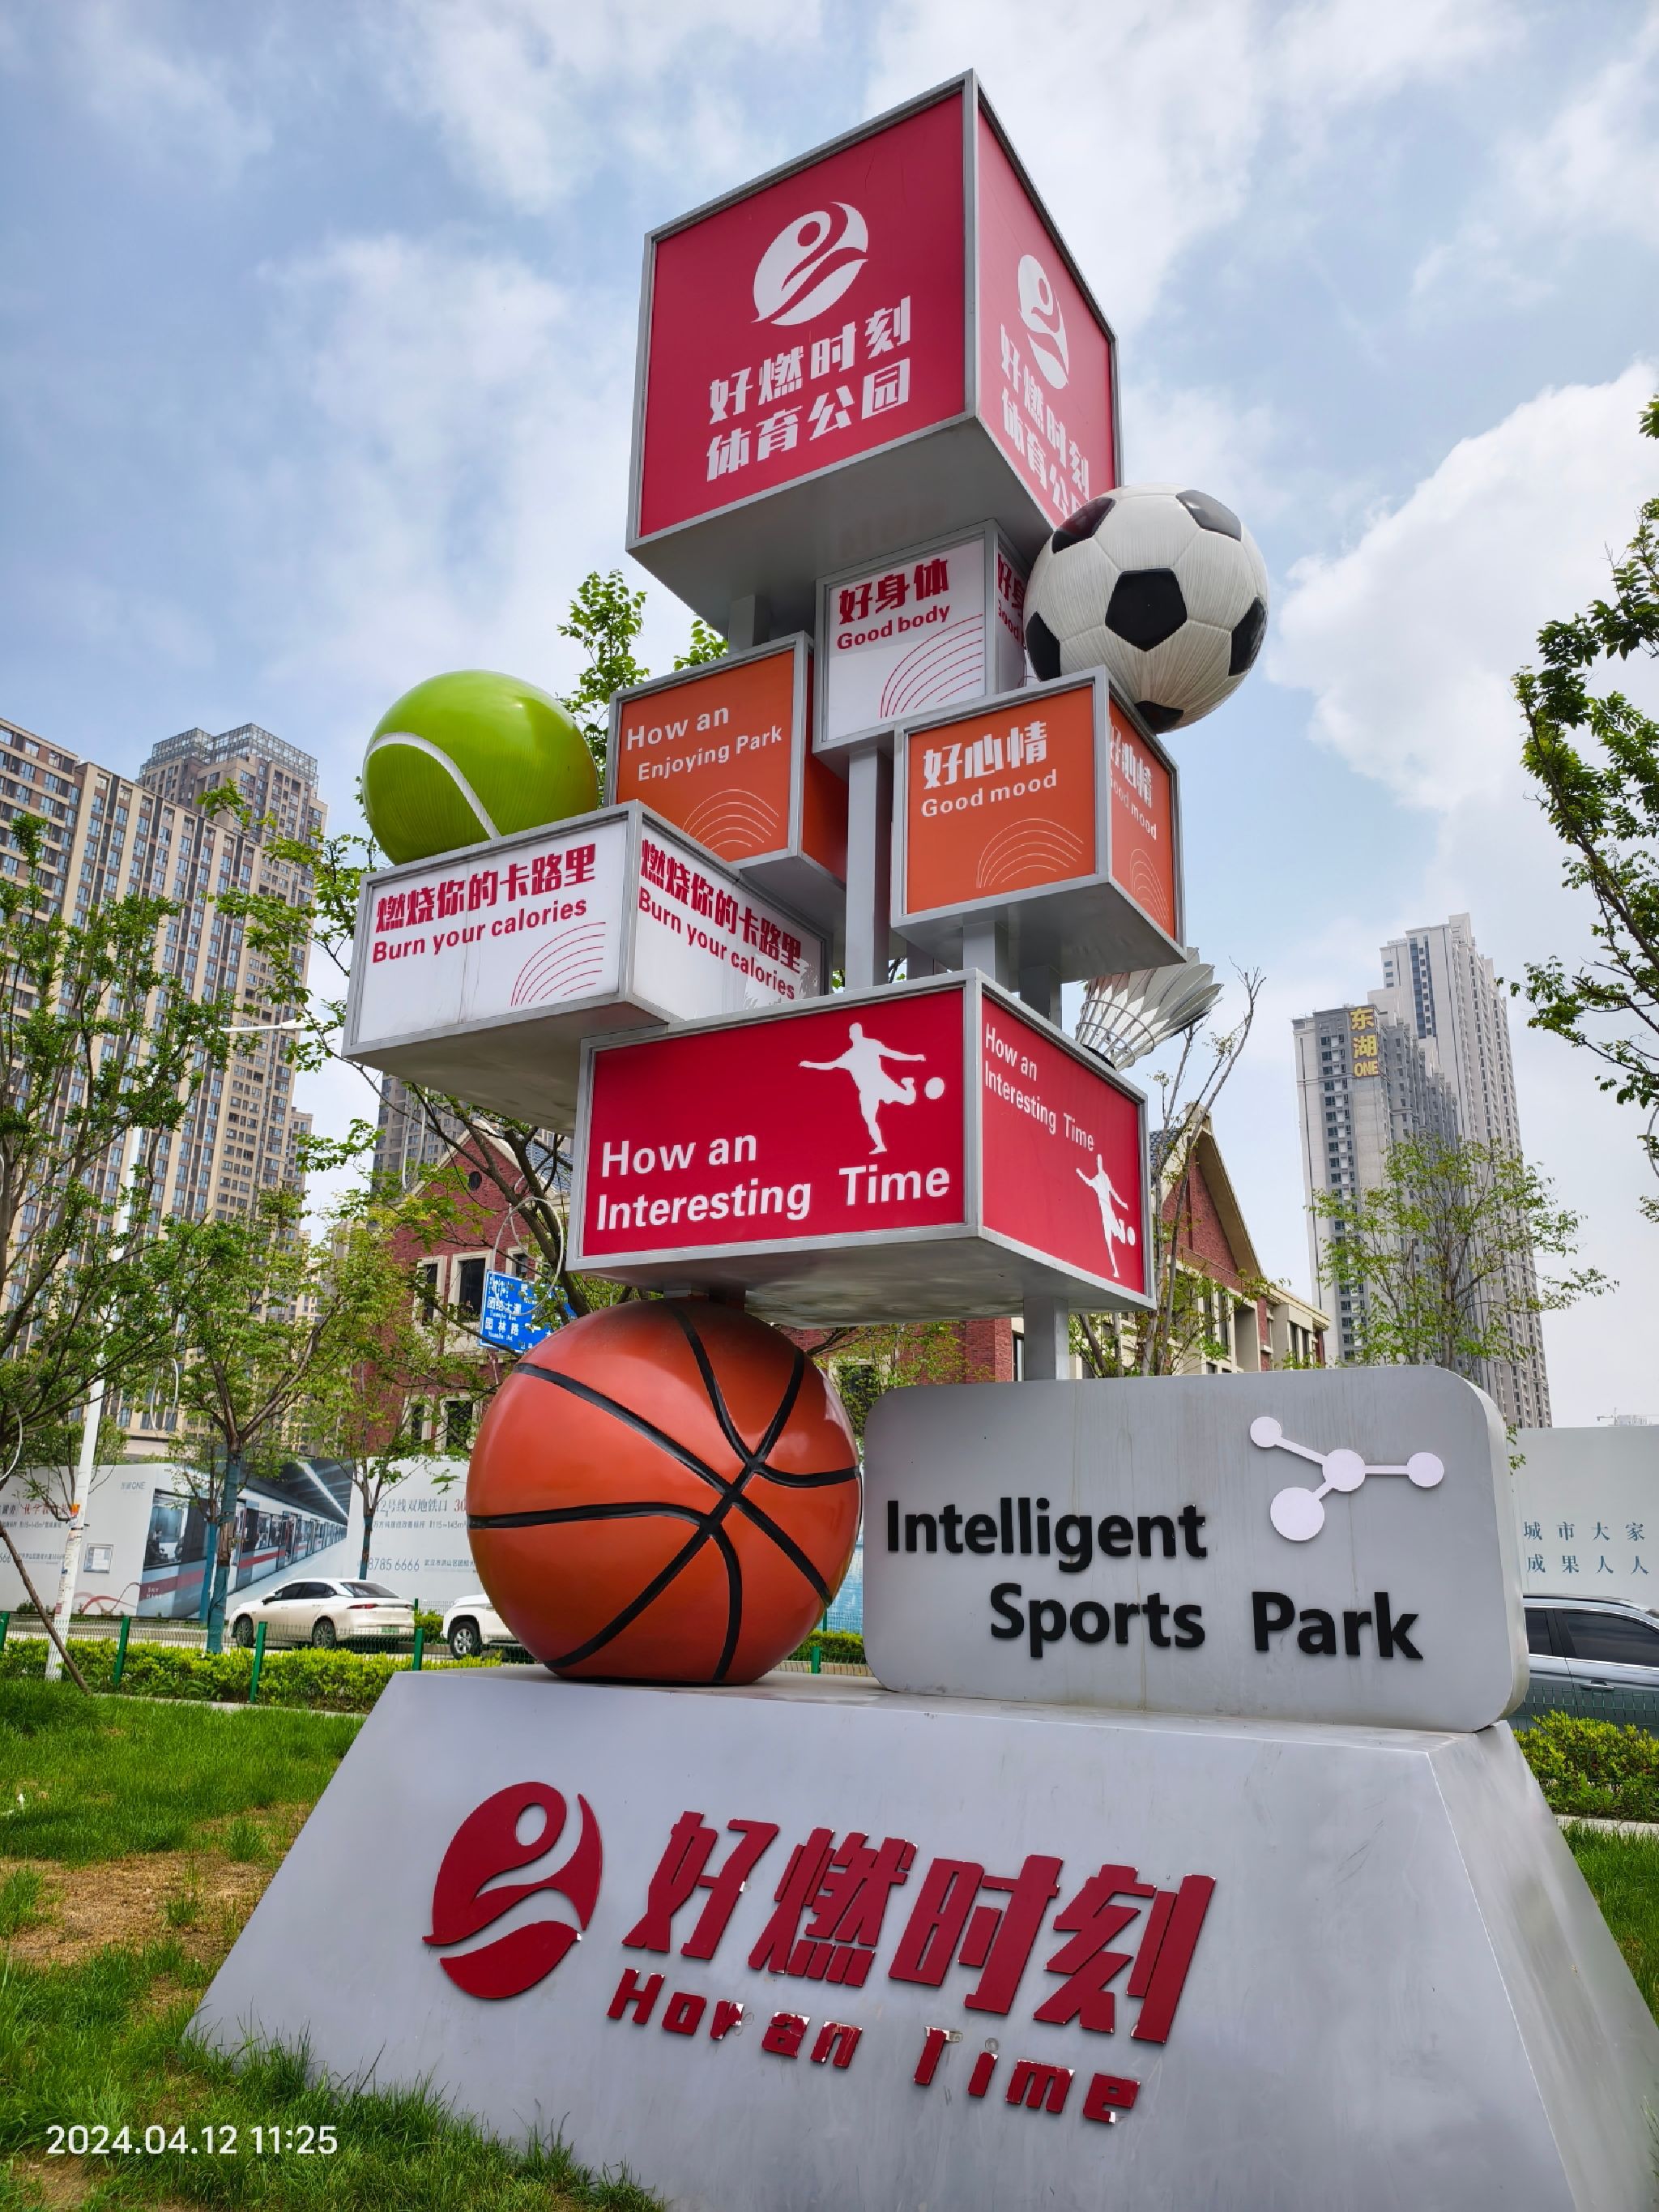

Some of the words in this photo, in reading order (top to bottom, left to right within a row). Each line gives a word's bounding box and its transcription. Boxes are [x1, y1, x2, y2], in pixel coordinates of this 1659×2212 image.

[710, 295, 910, 424] 好燃时刻
[706, 357, 910, 482] 体育公园
[1001, 323, 1089, 502] 好燃时刻
[838, 558, 949, 626] 好身体
[837, 620, 892, 649] Good
[898, 605, 950, 634] body
[627, 719, 689, 750] How
[697, 707, 729, 731] an
[638, 745, 729, 781] Enjoying
[736, 724, 783, 754] Park
[923, 720, 1047, 789] 好心情
[921, 788, 983, 818] Good
[990, 769, 1057, 802] mood
[1111, 724, 1152, 809] 好心情
[1131, 802, 1157, 840] mood
[375, 843, 596, 934] 燃烧你的卡路里
[641, 839, 802, 974] 燃烧你的卡路里
[373, 937, 425, 963] Burn
[433, 921, 486, 954] your
[491, 899, 586, 937] calories
[638, 888, 682, 934] Burn
[687, 924, 726, 963] your
[731, 950, 795, 1001] calories
[985, 1023, 1017, 1067] How
[1021, 1056, 1038, 1081] an
[985, 1061, 1056, 1134] Interesting
[1063, 1112, 1094, 1151] Time
[601, 1140, 696, 1178] How
[709, 1134, 757, 1166] an
[596, 1177, 812, 1231] Interesting
[838, 1164, 951, 1206] Time
[394, 1557, 420, 1571] 6666
[887, 1497, 1208, 1573] Intelligent
[1523, 1521, 1645, 1541] 城市大家
[1528, 1554, 1648, 1575] 成果人人
[990, 1582, 1206, 1659] Sports
[1252, 1591, 1424, 1661] Park
[621, 1810, 1217, 2044] 好燃时刻
[913, 2026, 1141, 2124] Time
